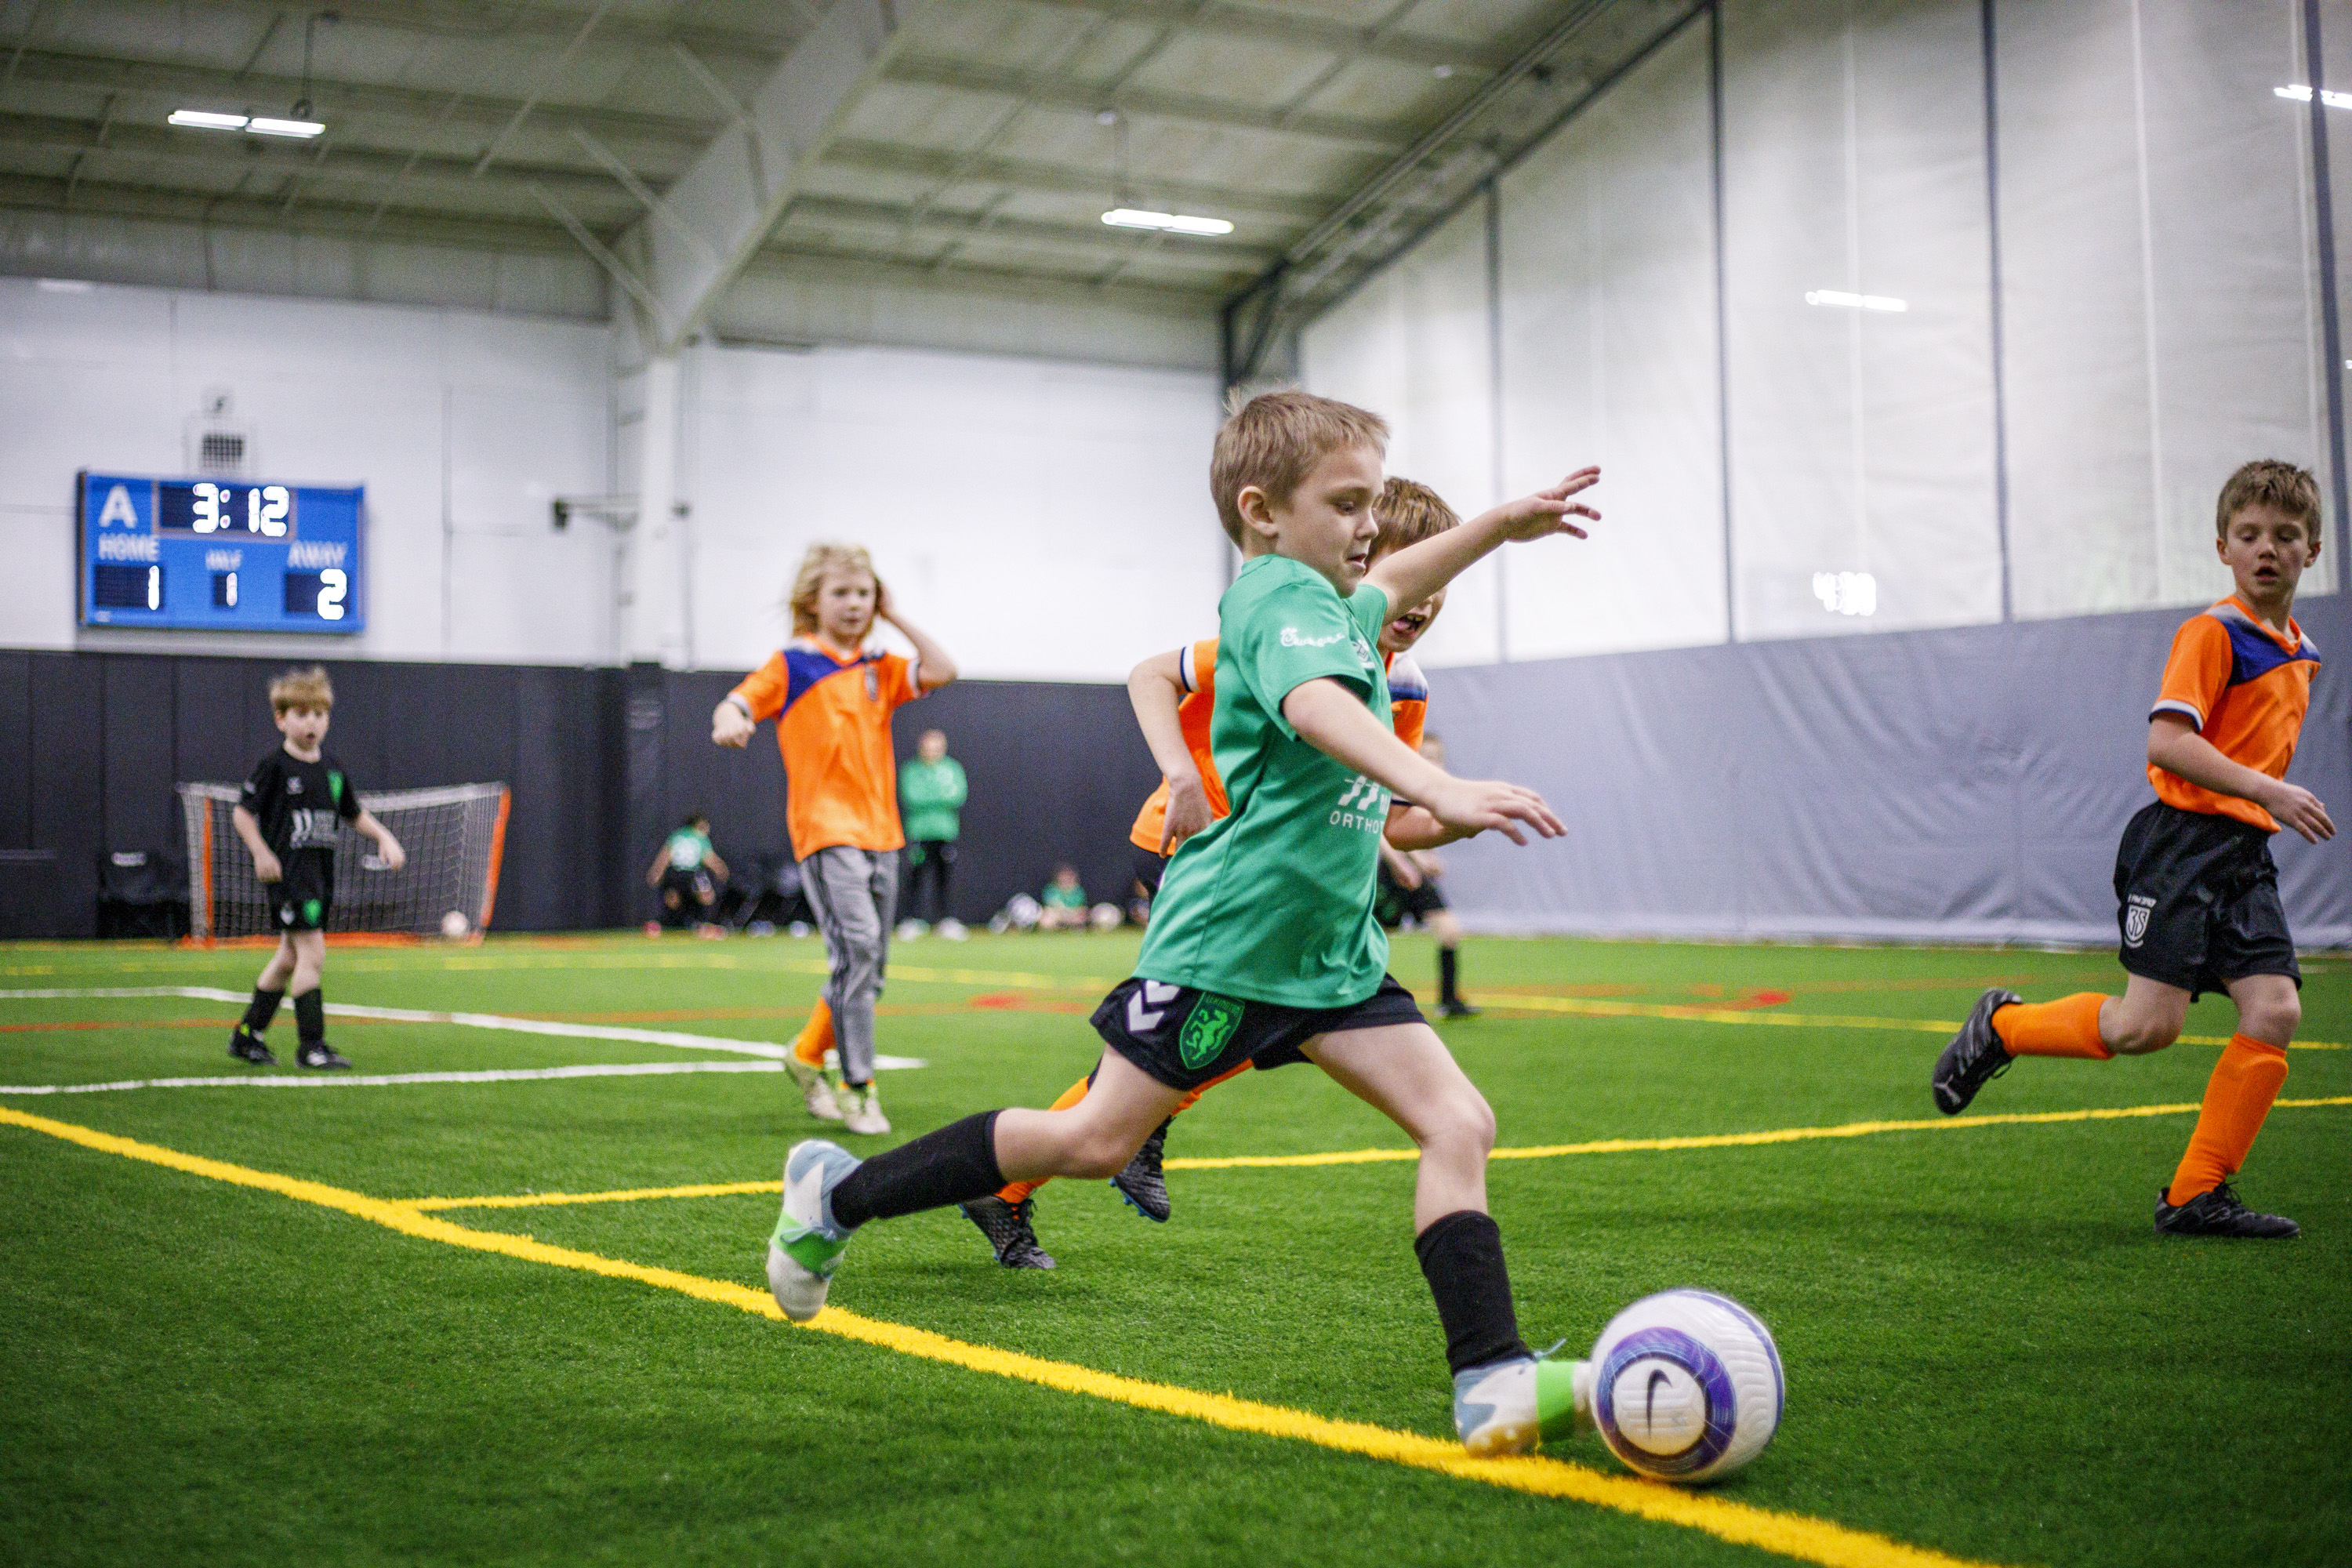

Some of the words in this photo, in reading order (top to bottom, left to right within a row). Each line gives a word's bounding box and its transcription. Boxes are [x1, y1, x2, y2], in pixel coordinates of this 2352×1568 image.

[98, 484, 137, 528] A
[193, 482, 289, 537] 3:12
[98, 532, 159, 562] HOME
[147, 565, 159, 610] 1
[227, 572, 238, 607] 1
[318, 568, 347, 620] 2
